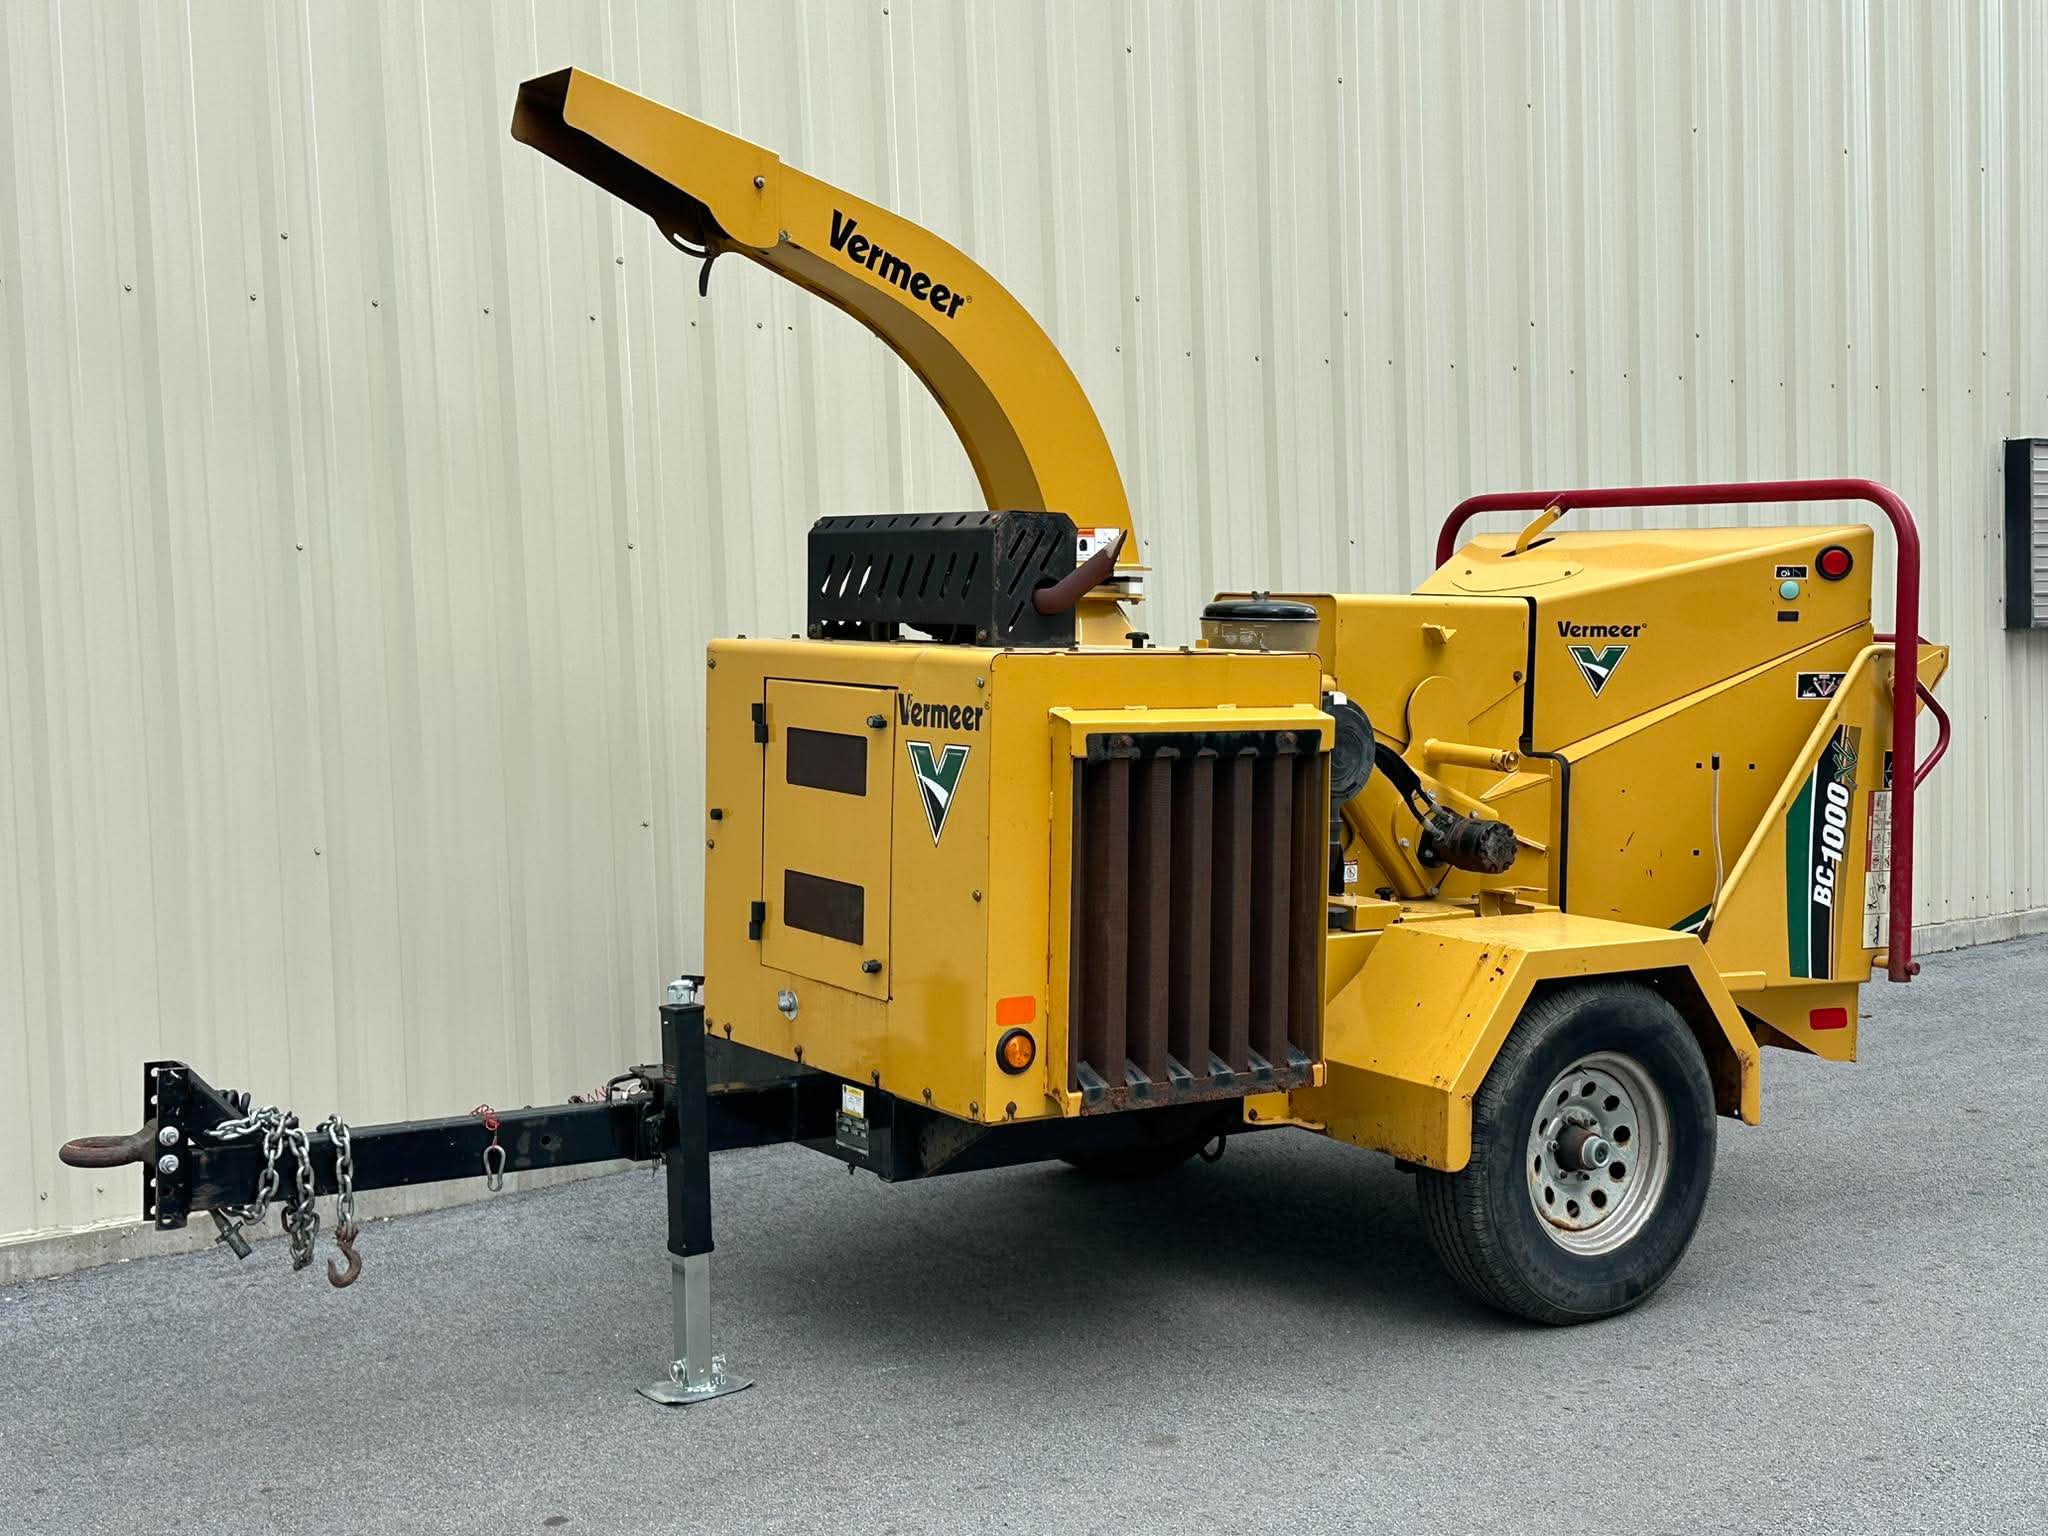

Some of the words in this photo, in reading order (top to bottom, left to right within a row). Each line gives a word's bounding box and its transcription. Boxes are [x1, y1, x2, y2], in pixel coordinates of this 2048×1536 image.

[830, 208, 965, 320] Vermeer
[1557, 620, 1641, 638] Vermeer
[898, 693, 983, 731] Vermeer
